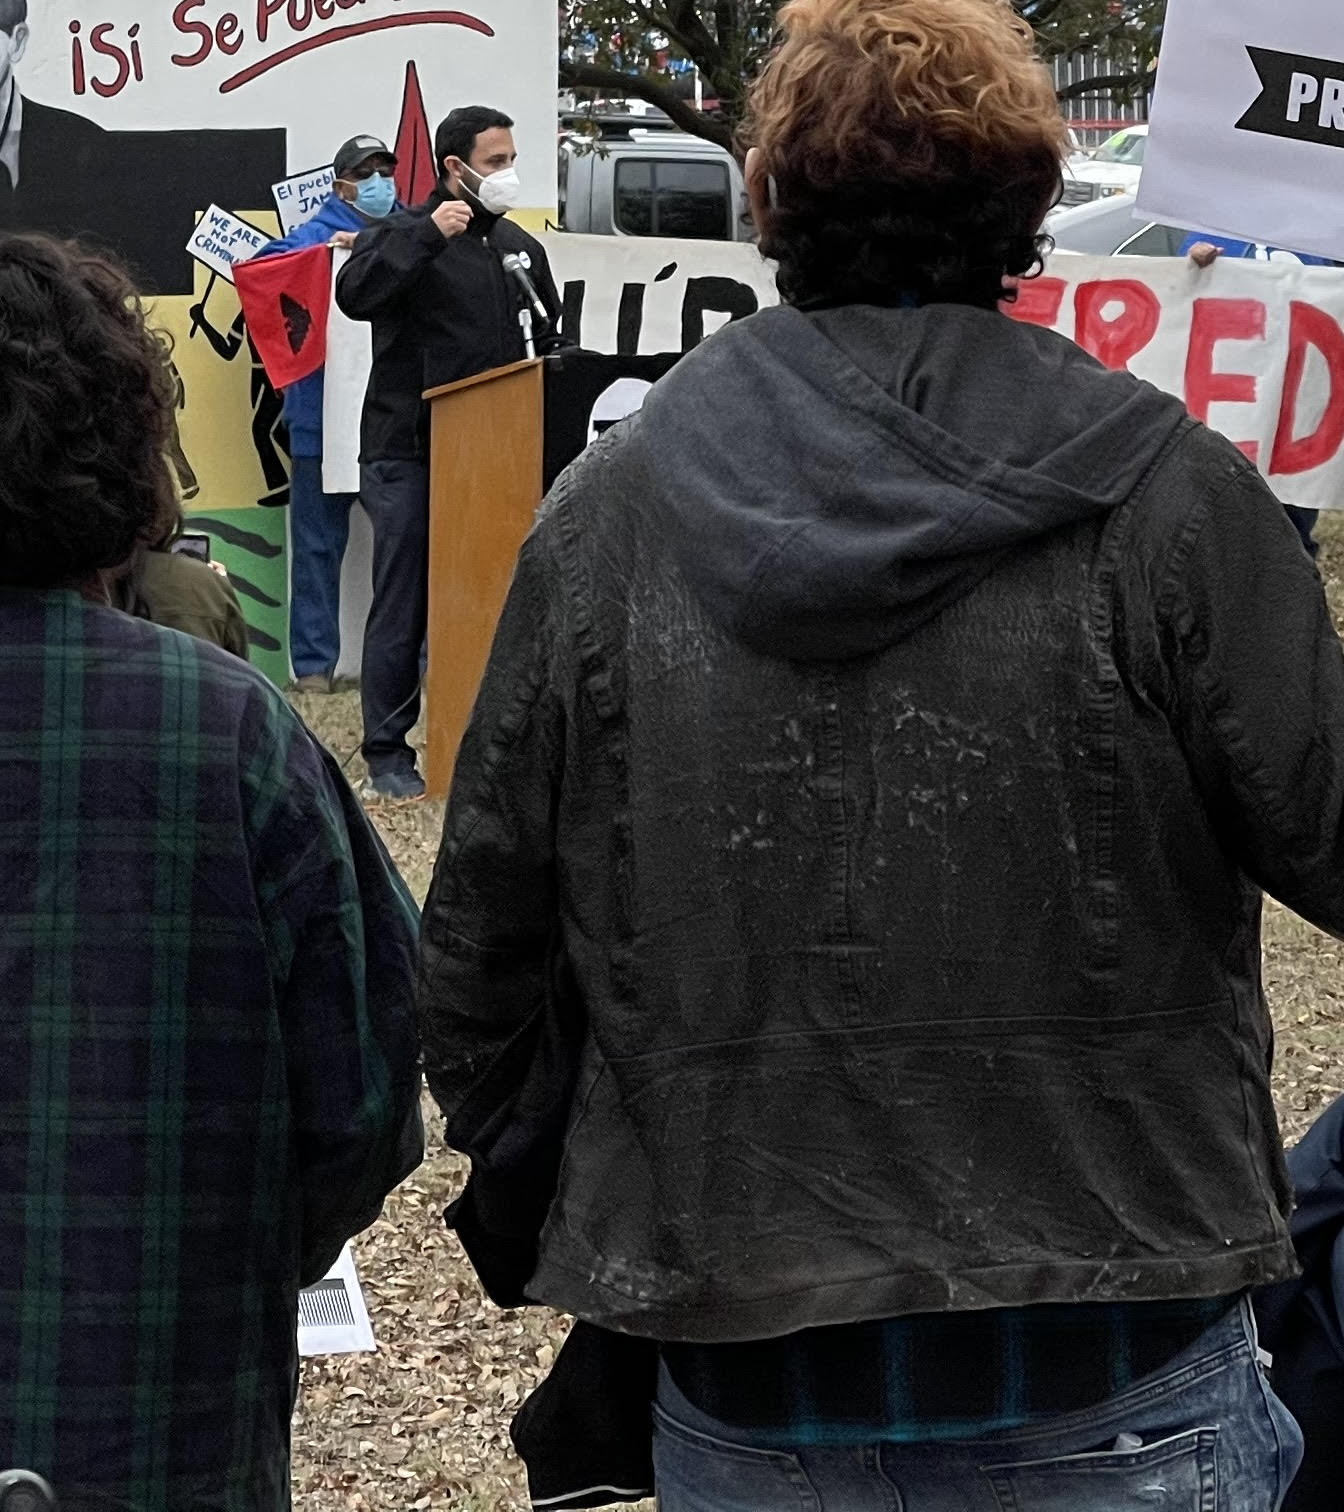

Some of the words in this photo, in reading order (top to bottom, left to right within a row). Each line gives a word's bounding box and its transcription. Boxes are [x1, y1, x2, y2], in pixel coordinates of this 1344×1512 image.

[298, 171, 335, 198] puebl
[209, 211, 231, 232] WE
[232, 223, 262, 248] ARE
[210, 228, 238, 248] NOT
